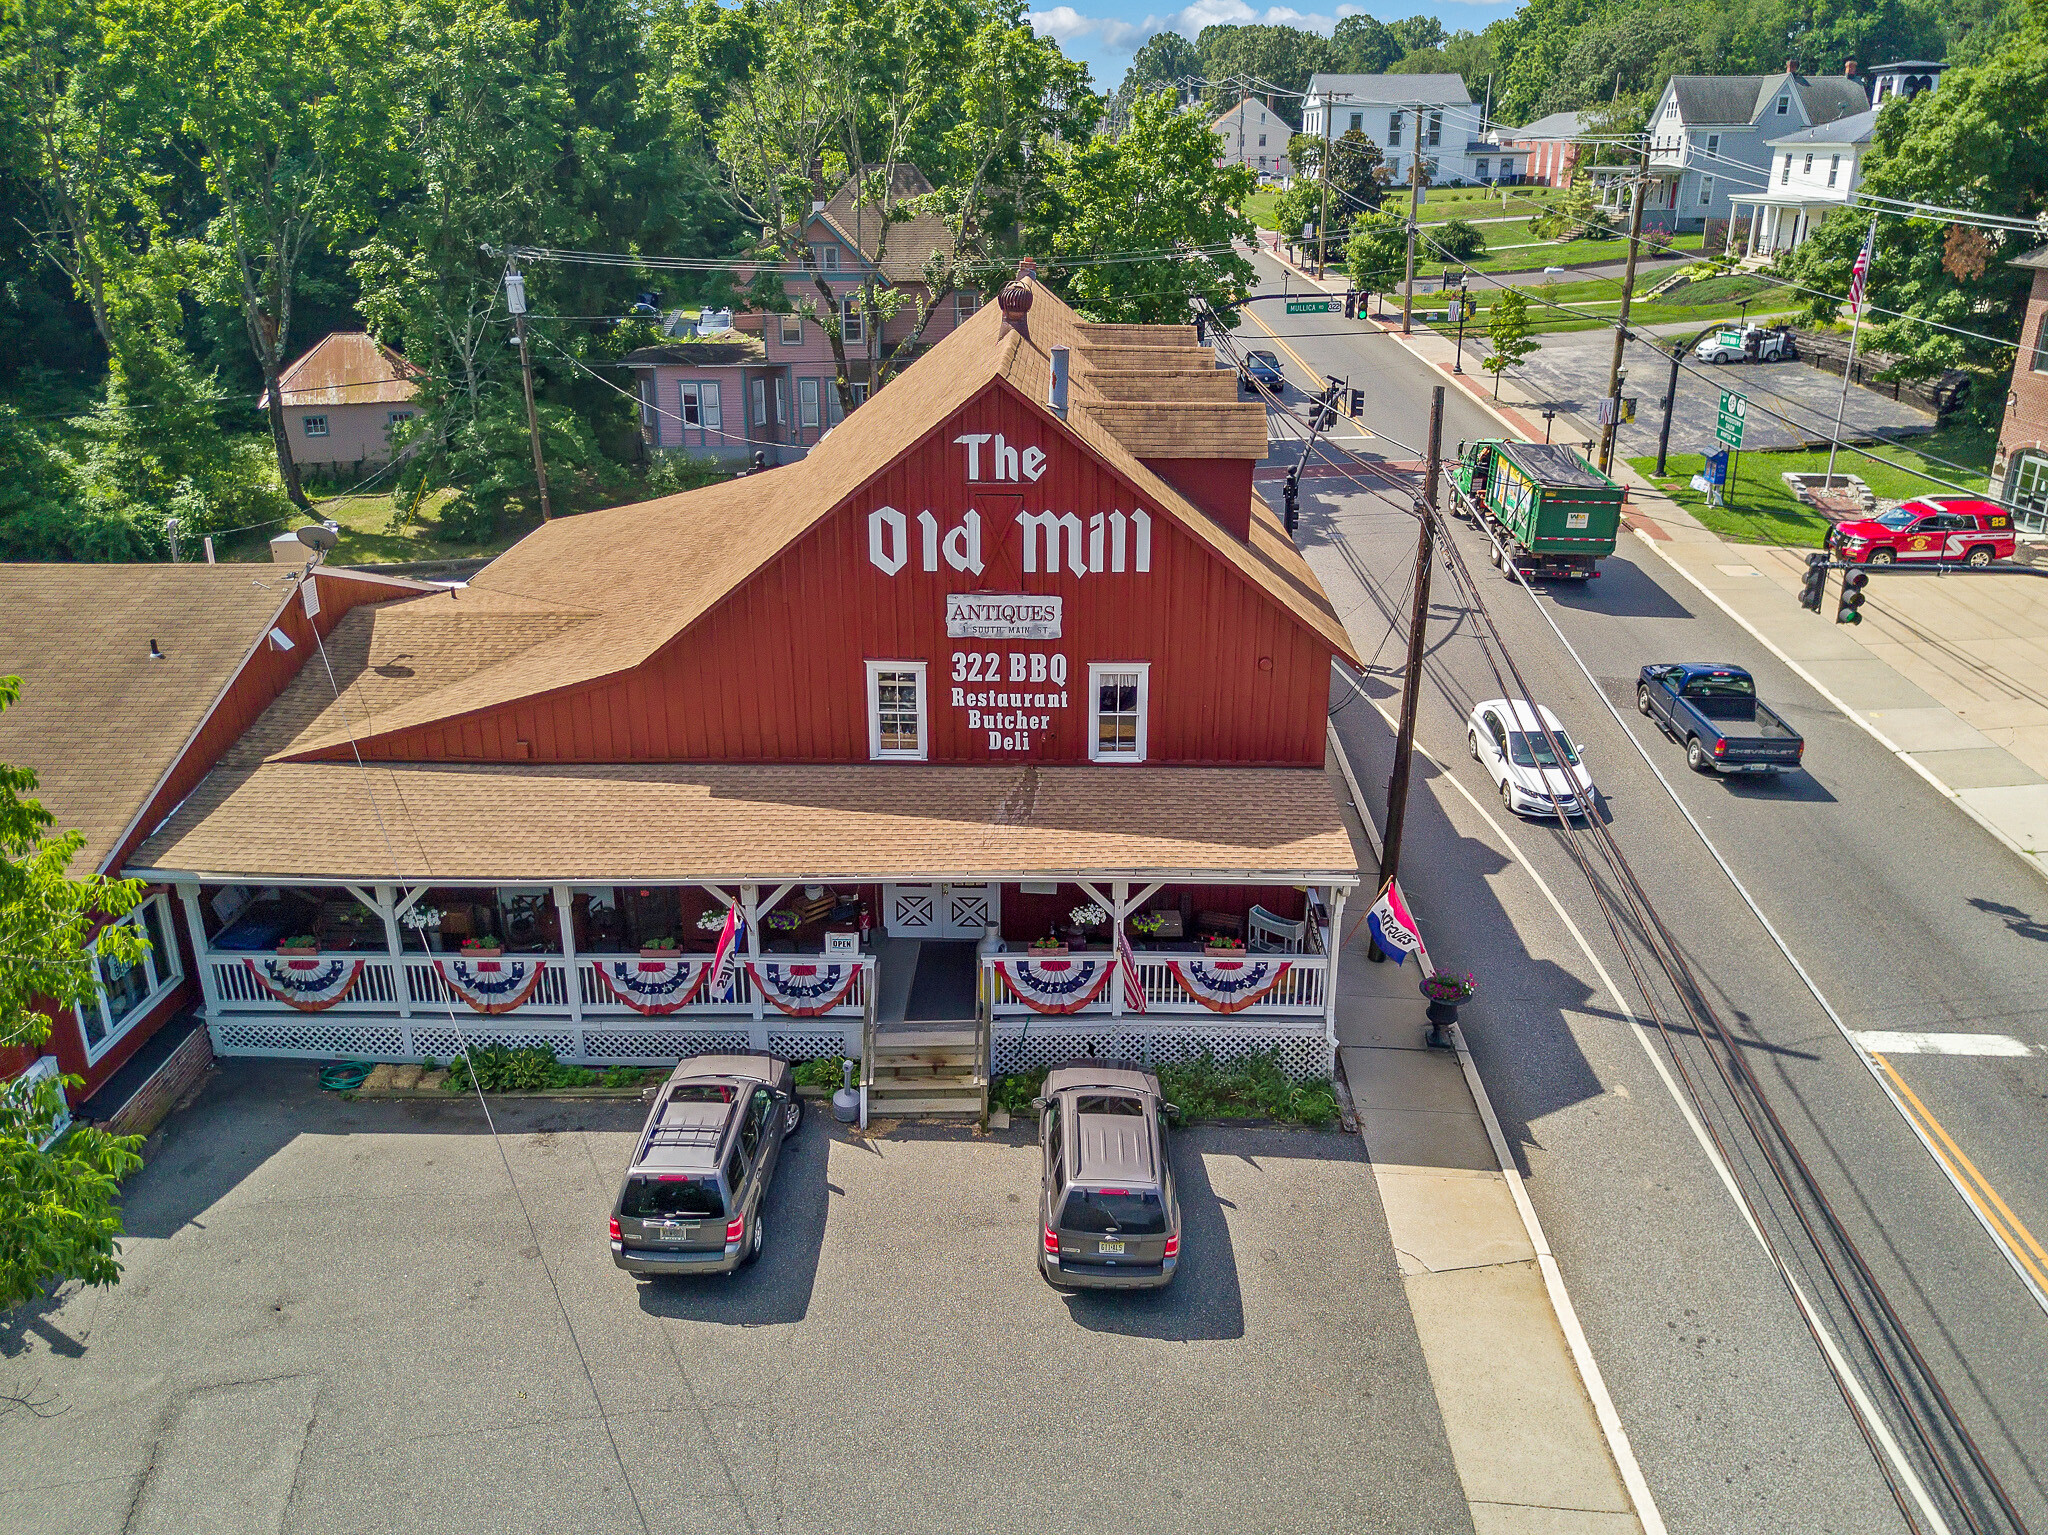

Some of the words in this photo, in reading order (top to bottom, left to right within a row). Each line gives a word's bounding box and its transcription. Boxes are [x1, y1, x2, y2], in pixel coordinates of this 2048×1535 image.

[1290, 304, 1316, 312] MULLICA
[953, 433, 1047, 482] The
[868, 506, 985, 576] Old
[1015, 508, 1151, 579] Mill
[951, 604, 1055, 624] ANTIQUES
[972, 626, 1003, 634] SOUTH
[1008, 626, 1030, 634] MAIN
[951, 652, 1000, 682] 322
[1009, 653, 1067, 687] BBQ
[951, 687, 1068, 707] Restaurant
[968, 710, 1050, 729] Butcher
[988, 731, 1030, 750] Deli
[832, 940, 851, 948] OPEN
